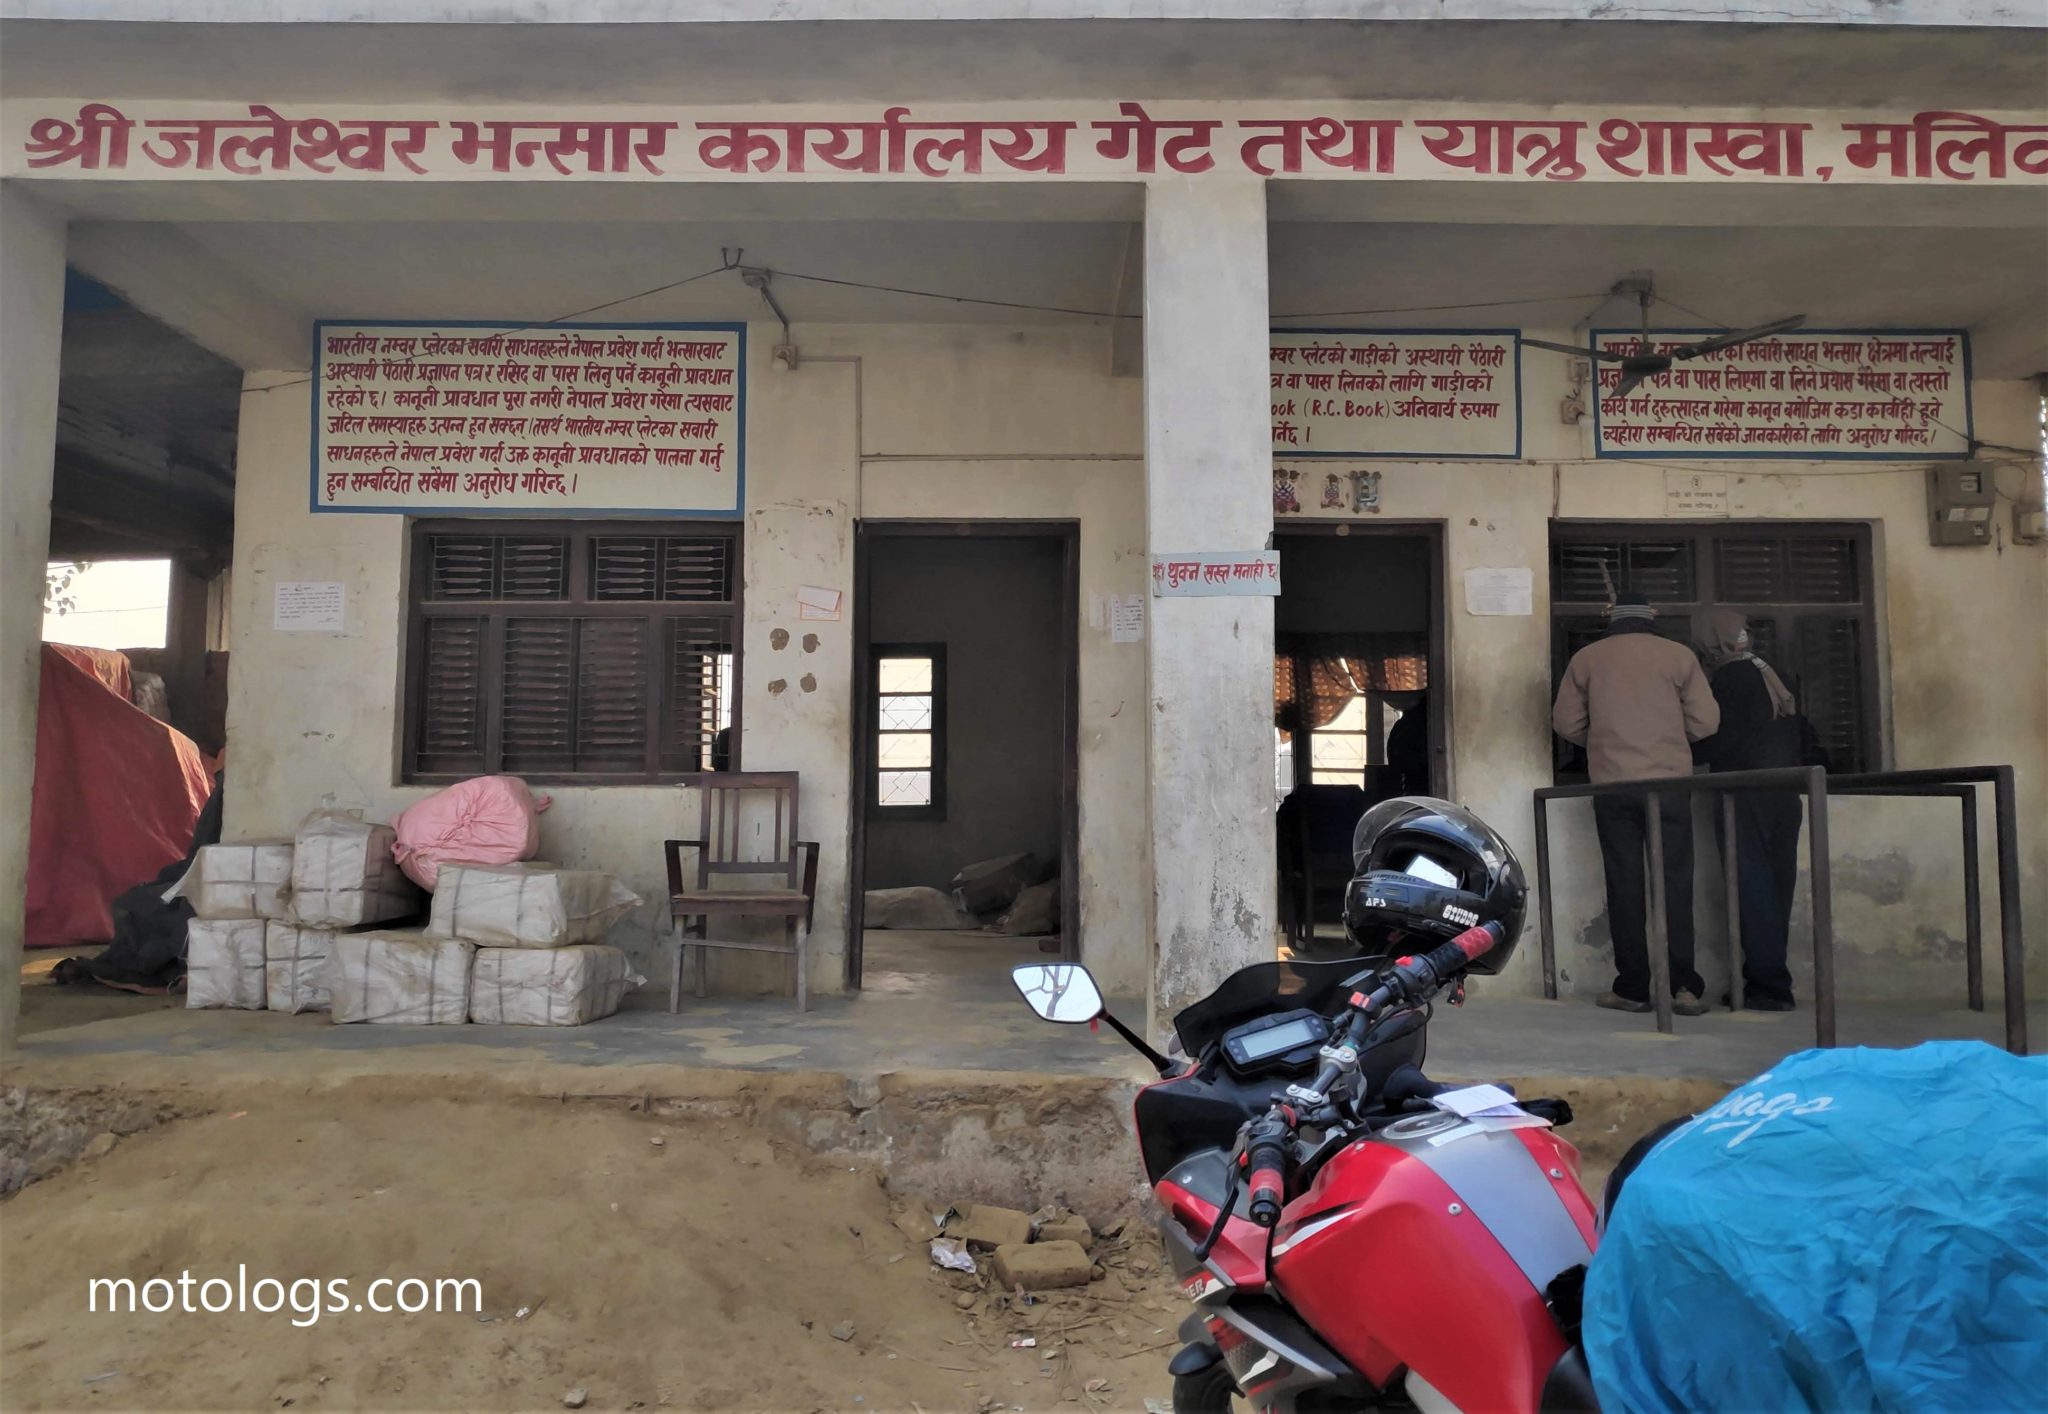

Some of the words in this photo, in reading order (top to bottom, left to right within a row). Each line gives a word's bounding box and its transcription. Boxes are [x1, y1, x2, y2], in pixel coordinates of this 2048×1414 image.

[25, 103, 135, 168] श्री
[144, 104, 438, 174] जलेश्वर
[452, 121, 678, 175] भन्सार
[697, 107, 1077, 177] कार्यालय
[1092, 103, 1222, 173] गेट
[1240, 117, 1402, 177] तथा
[1415, 119, 1586, 182] यात्रु
[327, 332, 380, 353] भारतीय
[421, 335, 466, 354] प्लेटका
[468, 335, 505, 357] सवारी
[571, 337, 605, 358] नेपाल
[607, 338, 639, 358] प्रवेश
[641, 336, 665, 361] गर्दा
[1299, 343, 1348, 364] प्लेटको
[1405, 346, 1464, 368] अस्थायी
[1746, 339, 1783, 363] सवारी
[1784, 340, 1819, 366] साधन
[1821, 340, 1864, 368] भन्सार
[327, 358, 380, 381] अस्थायी
[416, 362, 462, 382] प्रज्ञापन
[464, 362, 484, 381] पत्र
[485, 363, 496, 384] र
[497, 358, 530, 385] रसिद
[532, 363, 548, 384] वा
[550, 362, 580, 388] पास
[584, 361, 614, 388] लिनु
[615, 360, 637, 383] पर्ने
[638, 361, 683, 389] कानूनी
[684, 367, 734, 386] प्रावधान
[1286, 371, 1302, 389] वा
[1305, 371, 1334, 390] पास
[1389, 365, 1427, 393] लागि
[1674, 367, 1690, 390] वा
[1693, 368, 1722, 393] पास
[1724, 362, 1767, 391] लिएमा
[1769, 368, 1785, 391] वा
[1788, 362, 1820, 392] लिने
[1819, 362, 1855, 392] प्रयास
[1892, 361, 1908, 391] वा
[1908, 367, 1951, 392] त्यस्तो
[327, 386, 366, 413] रहेको
[393, 384, 440, 411] कानूनी
[443, 388, 500, 408] प्रावधान
[503, 389, 528, 413] पुरा
[530, 386, 564, 409] नगरी
[567, 384, 608, 409] नेपाल
[611, 384, 645, 411] प्रवेश
[649, 385, 683, 412] गरेमा
[1270, 399, 1295, 417] ook
[1391, 395, 1457, 418] अनिवार्य
[1459, 399, 1500, 420] रुपमा
[1713, 398, 1745, 424] गरेमा
[1746, 399, 1782, 422] कानून
[1834, 399, 1865, 422] कडा
[327, 410, 367, 434] जटिल
[368, 414, 427, 434] समस्याहरु
[429, 414, 468, 435] उत्पन्न
[468, 415, 489, 441] हुन
[564, 413, 605, 443] भारतीय
[636, 417, 678, 438] प्लेटका
[680, 418, 718, 440] सवारी
[1741, 419, 1810, 444] जानकारीको
[1810, 425, 1843, 444] लागि
[1846, 419, 1892, 449] अनुरोध
[327, 441, 398, 468] साधनहरुले
[400, 441, 438, 462] नेपाल
[440, 438, 477, 464] प्रवेश
[479, 441, 505, 466] गर्दा
[505, 444, 529, 465] उक्त
[532, 439, 577, 472] कानूनी
[578, 441, 651, 465] प्रावधानको
[654, 446, 697, 466] पालना
[699, 441, 725, 475] गर्नु
[326, 470, 350, 500] हुन
[351, 463, 415, 493] सम्बन्धित
[417, 467, 459, 494] सबैमा
[463, 463, 518, 500] अनुरोध
[521, 463, 565, 496] गरिन्छ
[1233, 558, 1265, 584] मनाही
